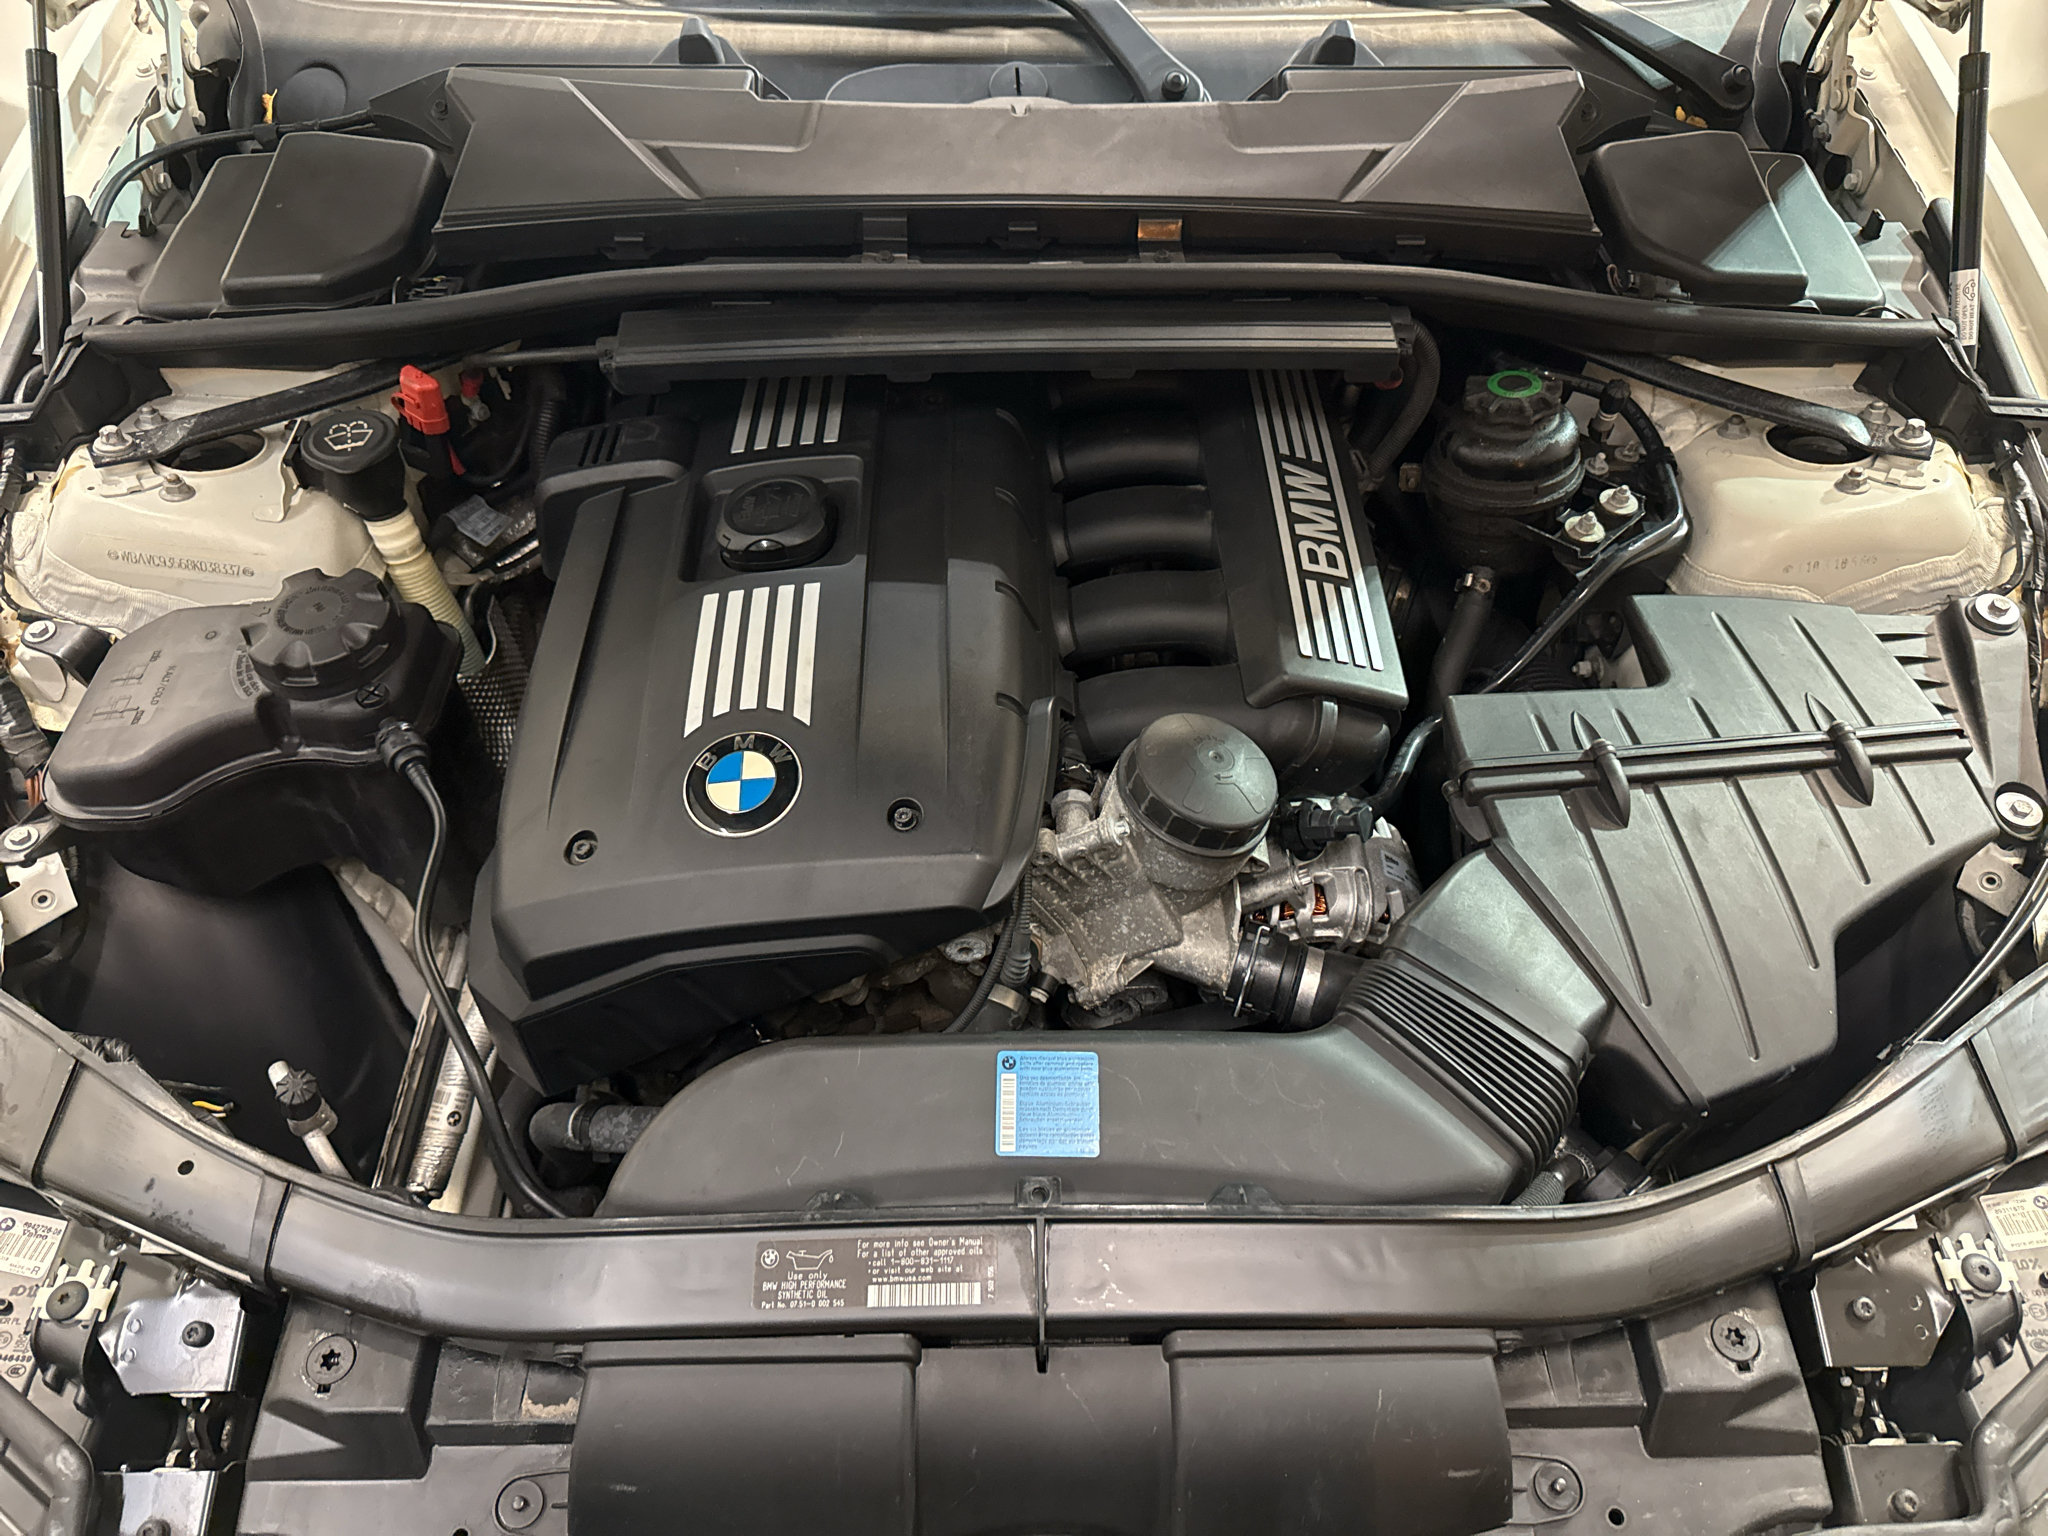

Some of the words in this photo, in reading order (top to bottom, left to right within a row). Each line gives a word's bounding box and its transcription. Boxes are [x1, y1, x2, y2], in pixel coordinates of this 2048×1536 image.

[1281, 461, 1350, 580] BMW
[695, 733, 794, 772] BMW
[857, 1239, 870, 1249] For
[873, 1240, 891, 1248] more
[894, 1238, 909, 1248] info
[928, 1237, 956, 1247] Owner's
[959, 1236, 983, 1247] Manual
[857, 1249, 870, 1259] For
[881, 1248, 895, 1257] list
[898, 1248, 907, 1257] of
[910, 1247, 930, 1257] other
[933, 1247, 966, 1259] approved
[969, 1246, 983, 1255] oils
[872, 1257, 887, 1267] call
[890, 1256, 955, 1266] 1-800-831-1117
[884, 1265, 901, 1274] visit
[920, 1265, 934, 1273] web
[937, 1264, 952, 1273] site
[955, 1264, 963, 1273] at
[787, 1271, 803, 1280] Use
[808, 1270, 828, 1281] only
[872, 1274, 932, 1284] www.bmwusa.com
[762, 1281, 779, 1292] BMW
[781, 1280, 797, 1290] HIGH
[800, 1279, 848, 1289] PERFORMANCE
[777, 1291, 814, 1300] SYNTHETIC
[816, 1290, 828, 1299] OIL
[761, 1300, 775, 1310] Part
